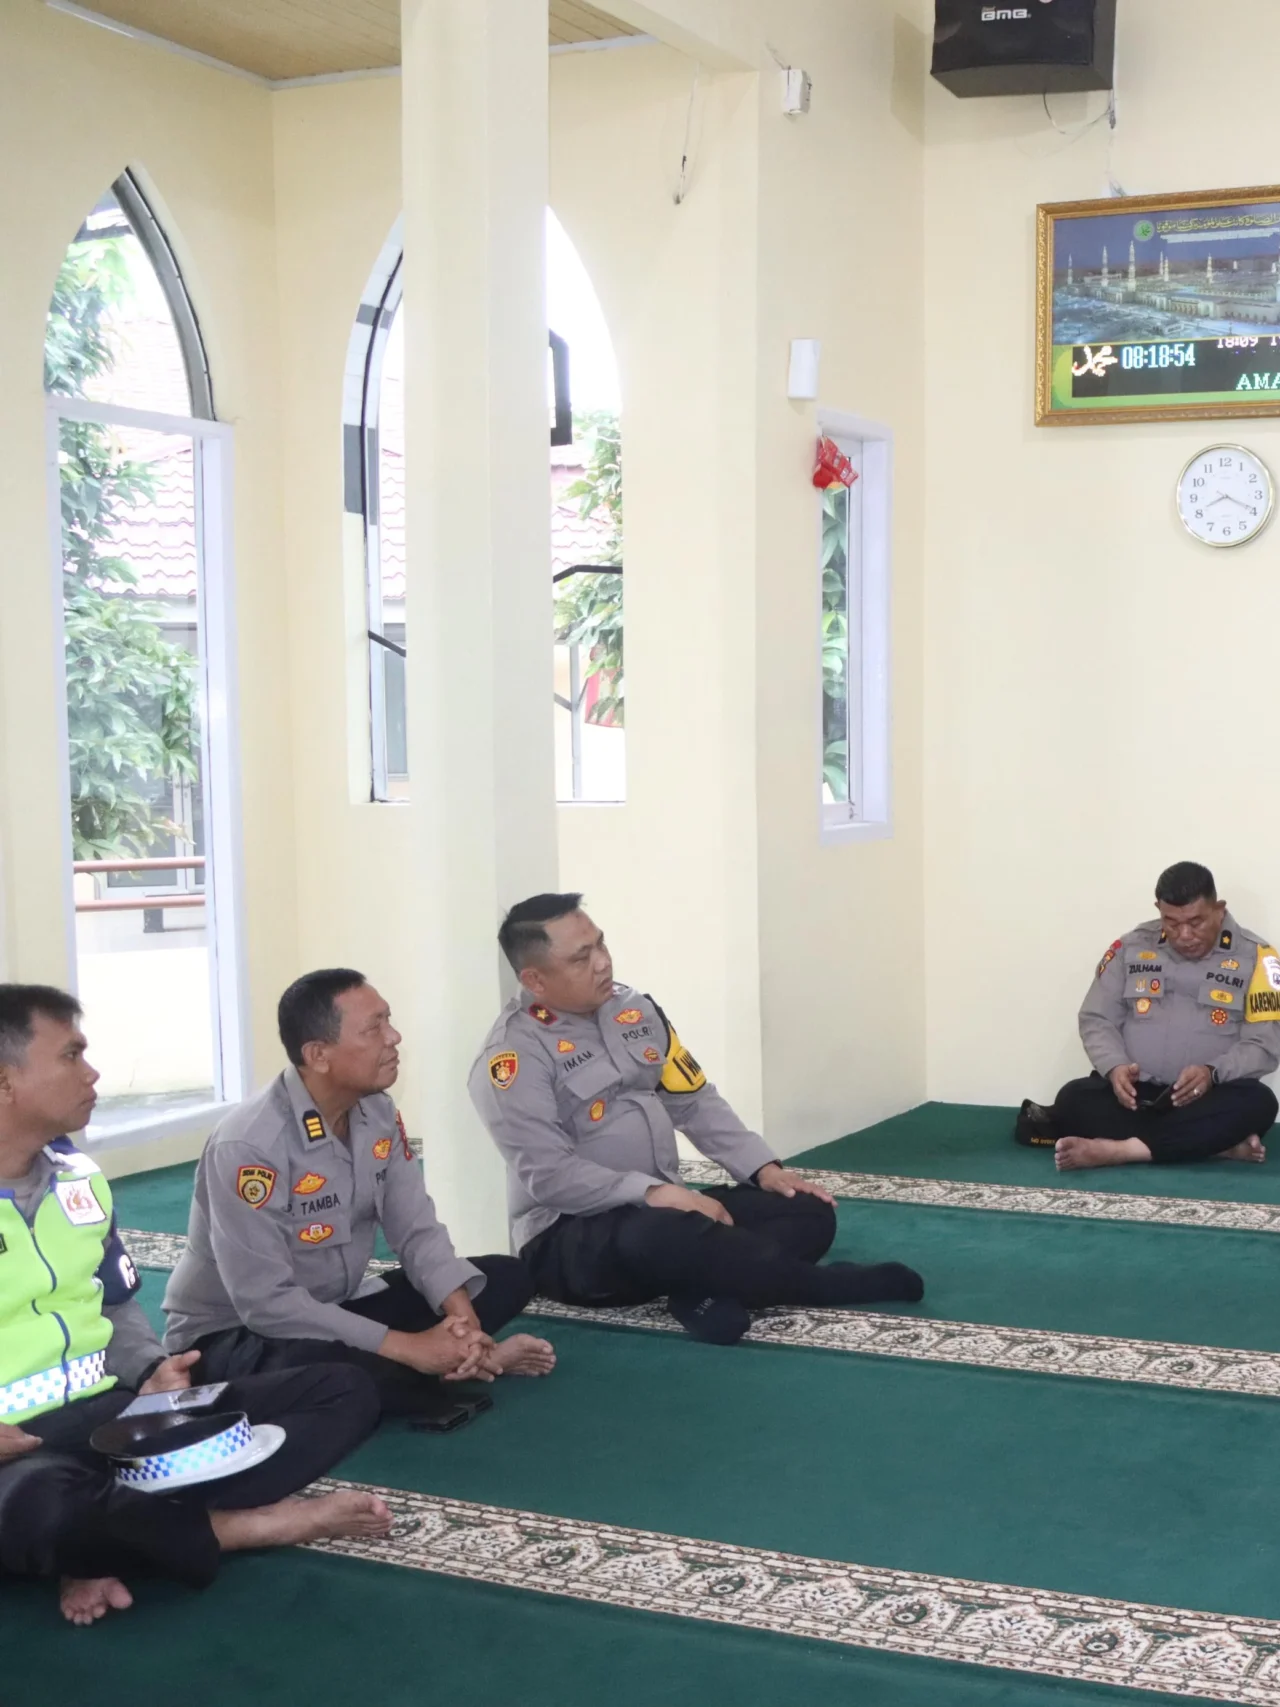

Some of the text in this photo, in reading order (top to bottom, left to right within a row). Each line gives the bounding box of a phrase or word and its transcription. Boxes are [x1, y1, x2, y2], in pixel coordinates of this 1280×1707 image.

[1122, 343, 1196, 369] 08:18:54
[1219, 457, 1232, 467] 12
[1203, 464, 1213, 473] 11
[1192, 477, 1205, 487] 10
[1249, 473, 1257, 483] 2
[1189, 494, 1198, 503] 9
[1254, 490, 1263, 500] 3
[1194, 509, 1203, 519] 8
[1249, 506, 1258, 516] 4
[1206, 522, 1215, 532] 7
[1238, 521, 1247, 530] 5
[1222, 526, 1231, 536] 6
[1129, 964, 1163, 975] ZULHAM
[1206, 972, 1245, 989] POLRI
[622, 1026, 653, 1041] POLRI
[564, 1050, 595, 1072] IMAM
[300, 1193, 341, 1215] TAMBA
